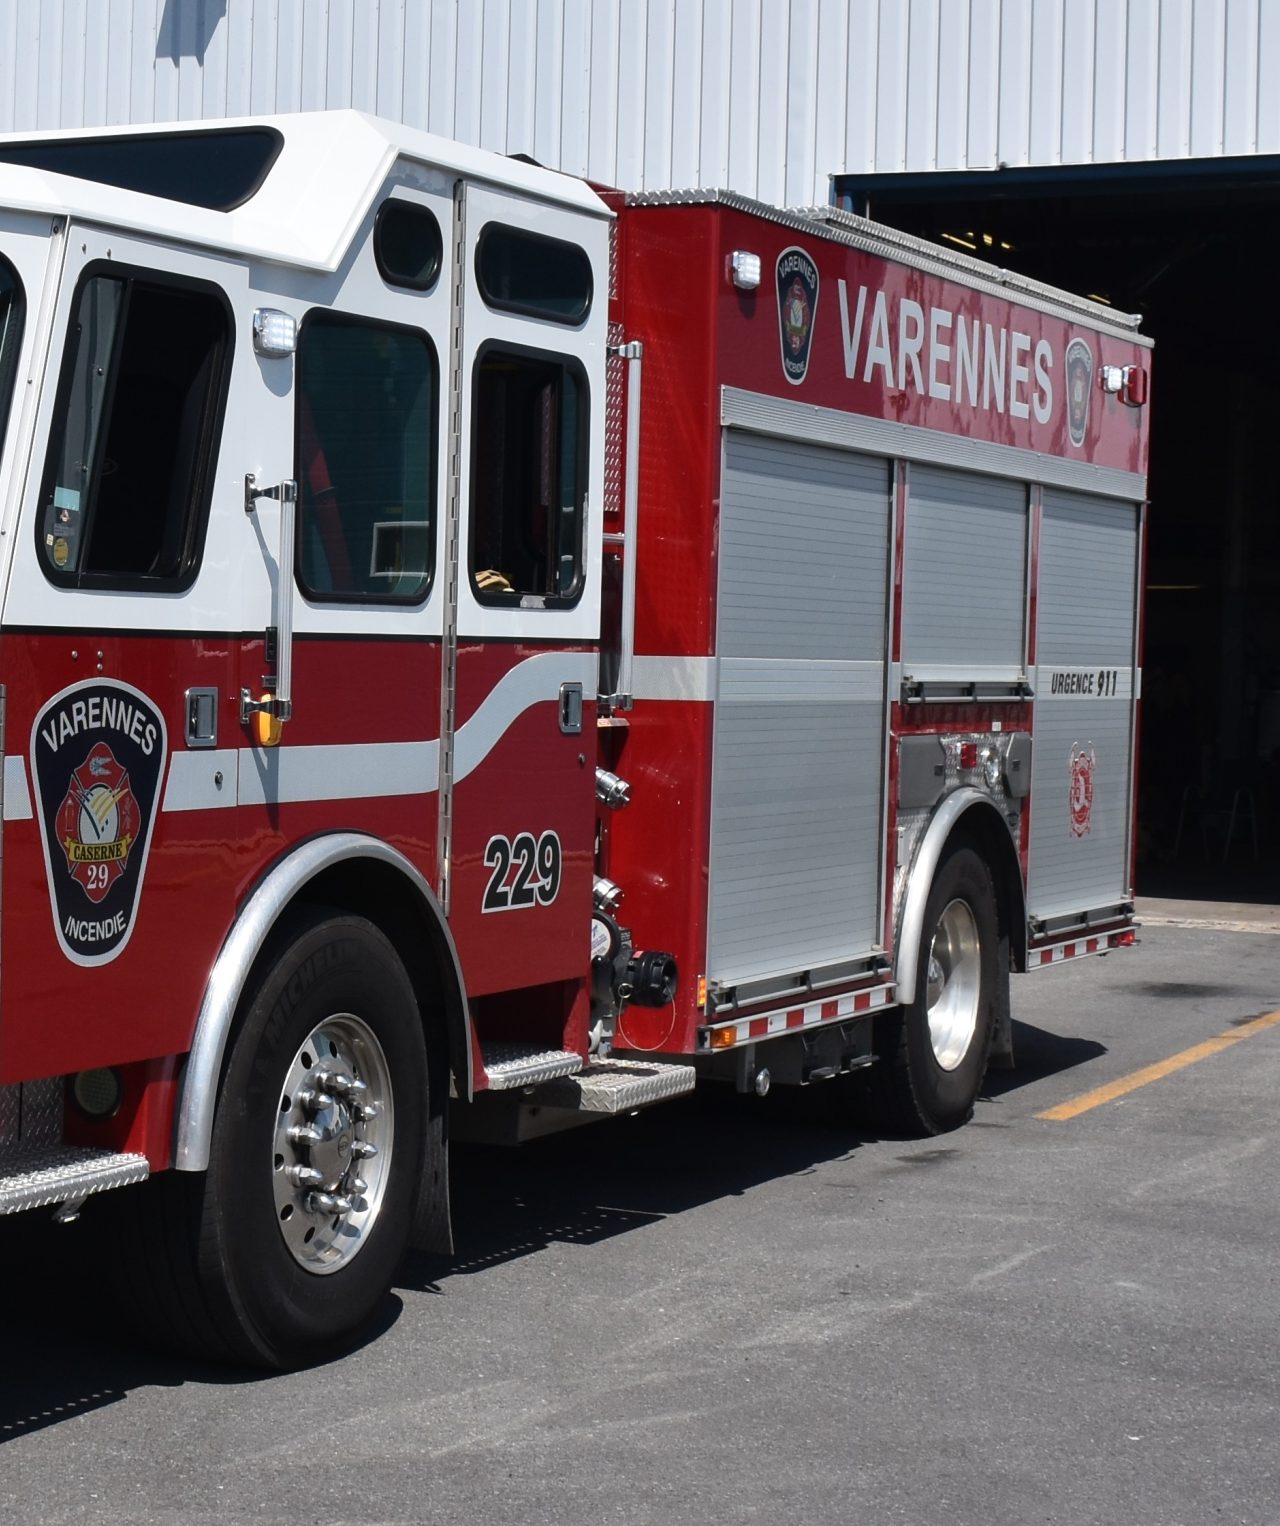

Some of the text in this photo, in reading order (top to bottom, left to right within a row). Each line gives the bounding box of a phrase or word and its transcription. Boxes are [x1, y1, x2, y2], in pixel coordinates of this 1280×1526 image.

[779, 255, 817, 290] VARENNES
[837, 278, 1053, 424] VARENNES
[1051, 670, 1118, 697] URGENCE 911
[41, 696, 157, 756] VARENNES
[73, 843, 123, 861] CASERNE
[86, 863, 109, 890] 29
[481, 829, 562, 914] 229
[64, 910, 127, 942] INCENDIE
